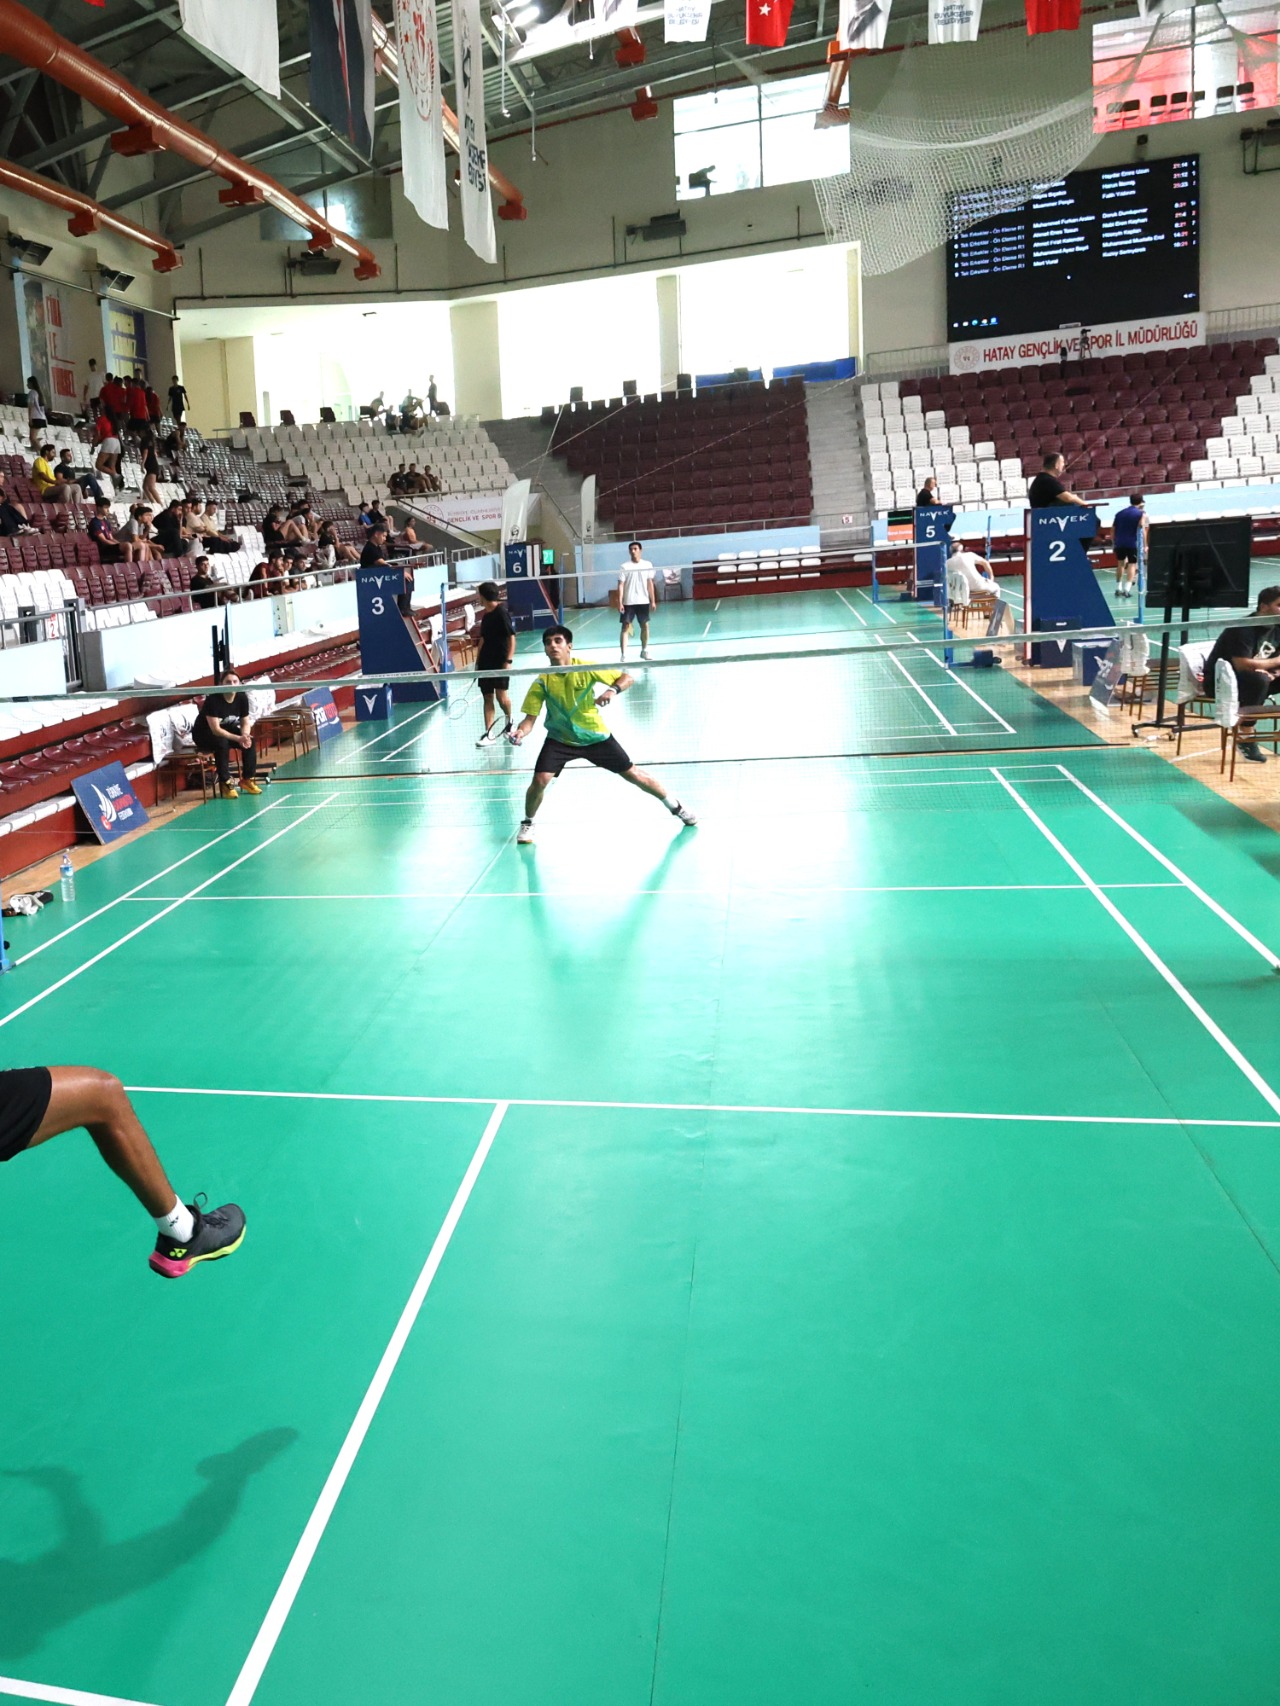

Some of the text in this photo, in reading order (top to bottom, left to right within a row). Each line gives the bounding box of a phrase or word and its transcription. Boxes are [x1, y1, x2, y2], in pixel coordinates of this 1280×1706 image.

[982, 346, 1016, 363] HATAY
[1017, 337, 1063, 361] GENÇLİK
[1065, 339, 1080, 356] VE
[1115, 328, 1125, 347] İL
[1127, 319, 1199, 345] MÜDÜRLÜĞÜ
[925, 525, 936, 539] 5
[1038, 514, 1088, 532] NAVEK
[1048, 540, 1067, 562] 2
[512, 561, 522, 574] 6
[361, 574, 398, 590] NAVEK
[371, 596, 385, 615] 3
